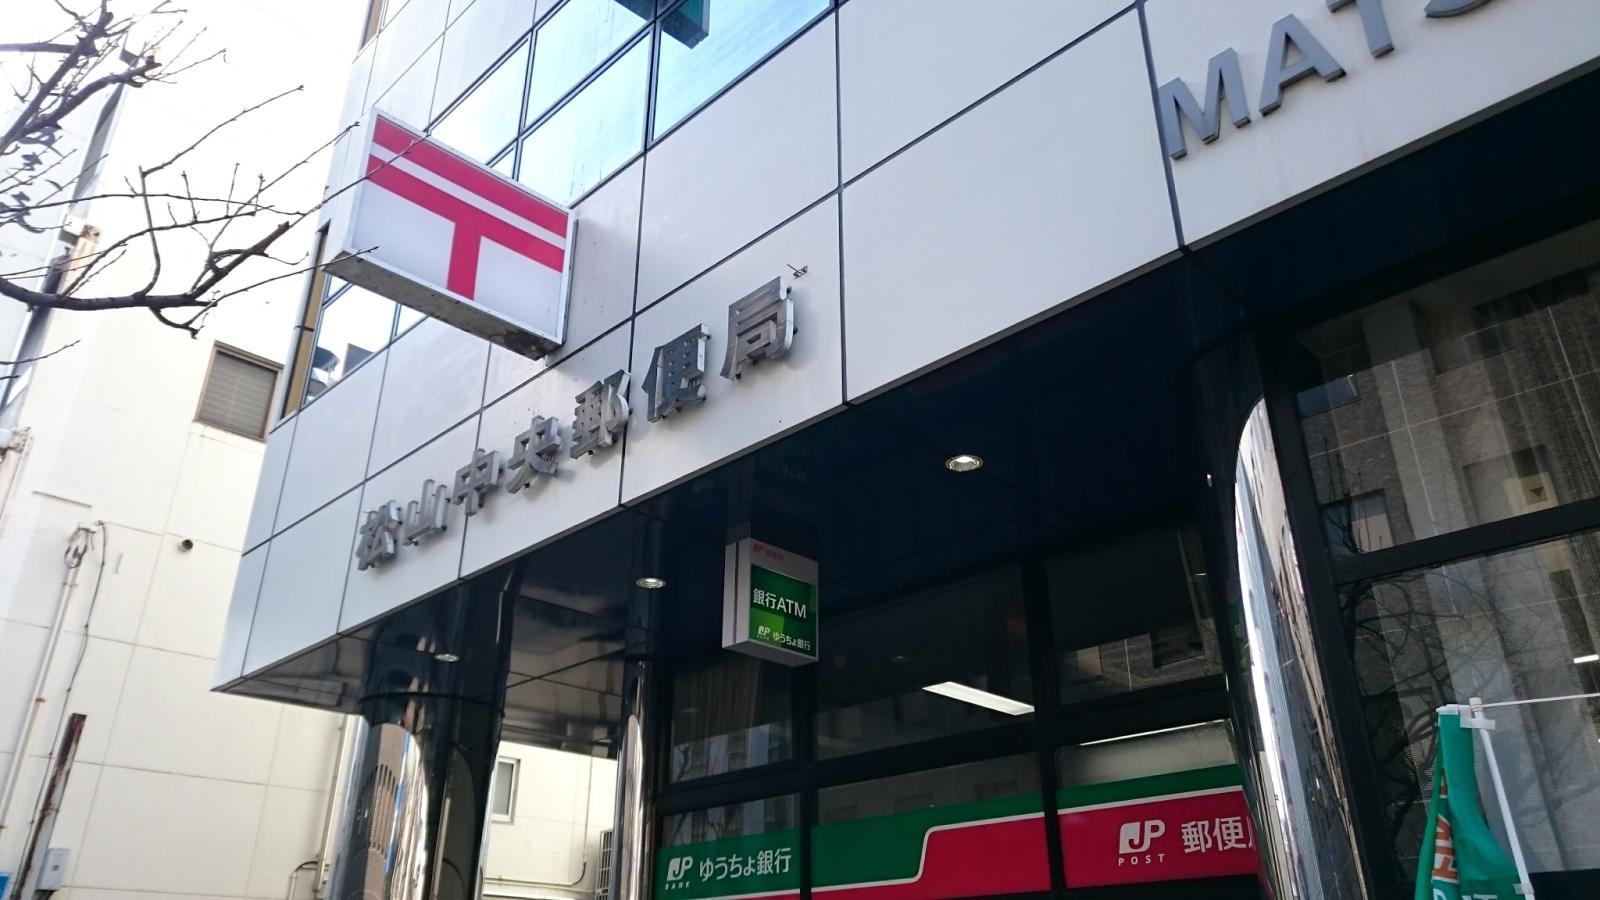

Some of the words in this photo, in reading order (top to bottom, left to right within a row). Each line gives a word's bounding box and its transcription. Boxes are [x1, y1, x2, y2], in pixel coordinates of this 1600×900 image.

[1158, 0, 1492, 160] MAT
[356, 275, 798, 571] 松山中央郵便局
[753, 588, 806, 619] 銀行ATM
[699, 847, 792, 883] ゆうちょ銀行
[1118, 854, 1165, 866] POST
